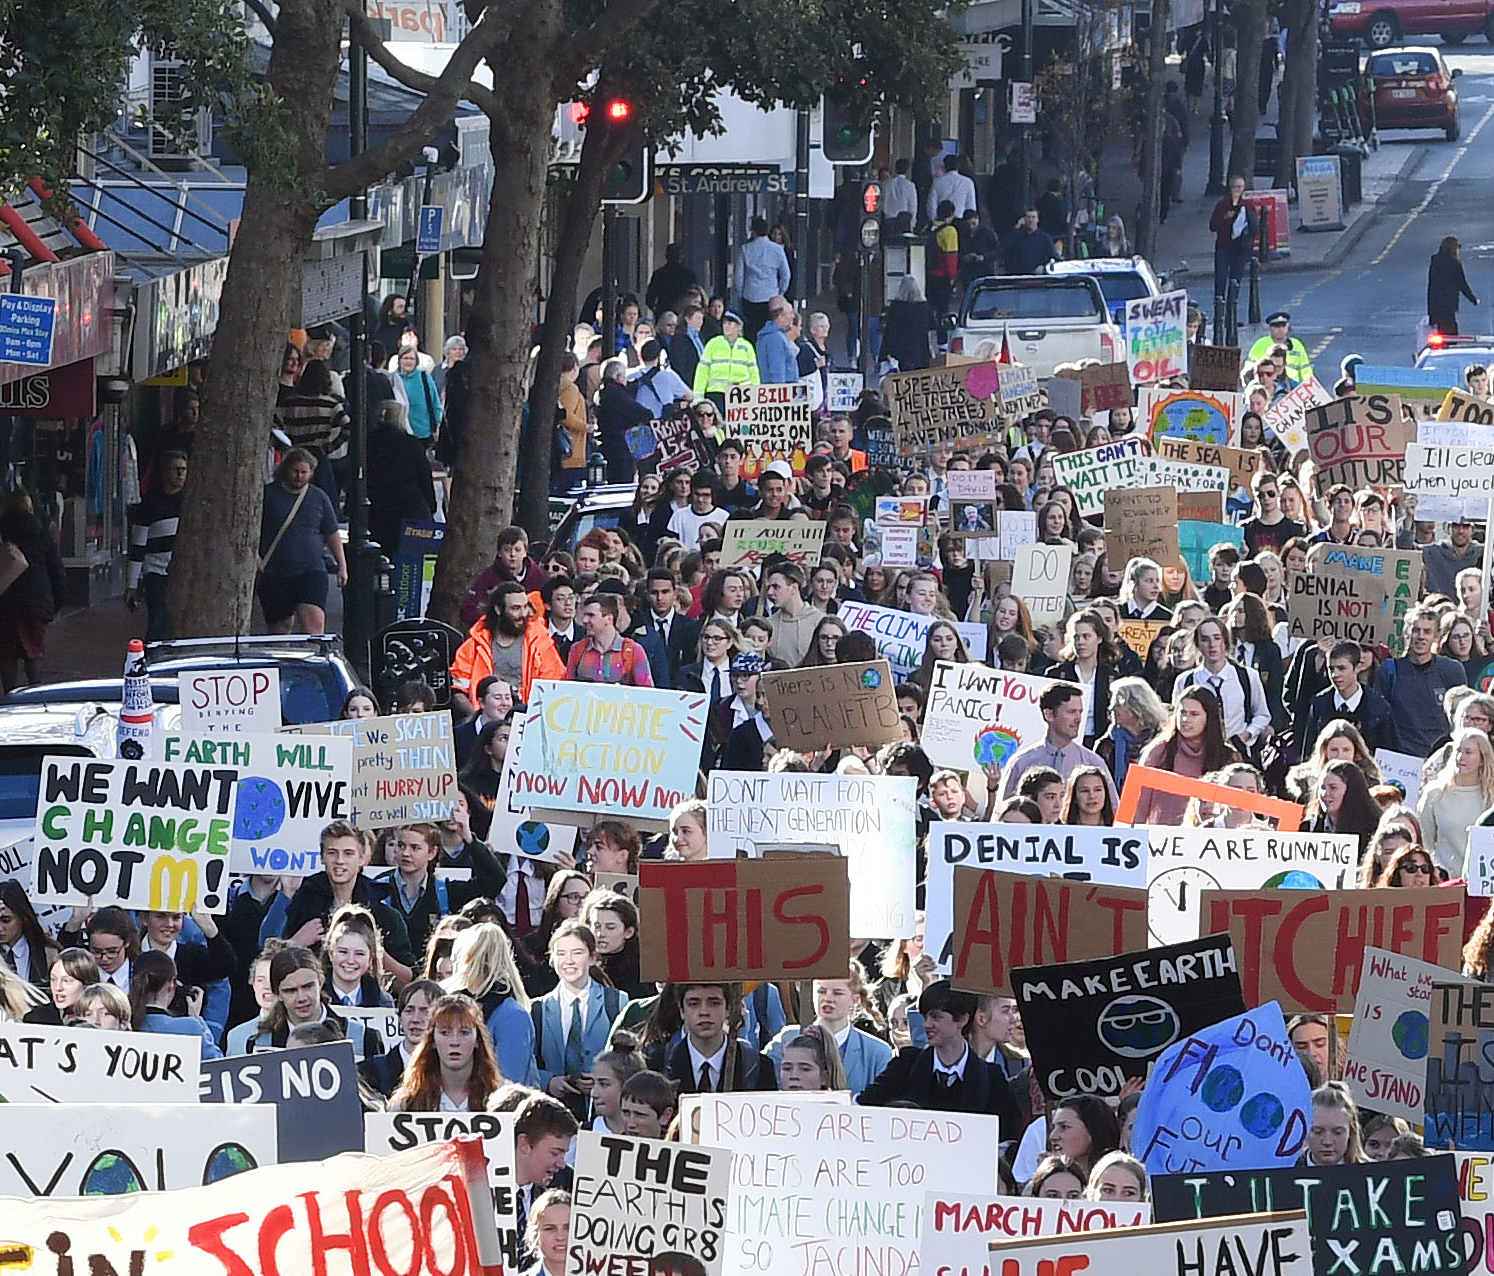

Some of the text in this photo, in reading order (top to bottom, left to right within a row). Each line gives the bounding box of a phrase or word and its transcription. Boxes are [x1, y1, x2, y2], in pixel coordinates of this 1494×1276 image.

[668, 175, 788, 192] St. Andrew St
[1128, 295, 1187, 321] SWEAT
[1132, 358, 1181, 381] OIL
[729, 386, 791, 404] AS BILL
[895, 388, 966, 413] THE TREES
[728, 404, 810, 422] NYE SAID THE
[1162, 442, 1256, 473] THE SEA IS
[1294, 575, 1359, 598] DENIAL
[843, 604, 875, 632] THE
[1318, 599, 1373, 618] IS NOT
[1291, 618, 1375, 644] A POLICY!
[191, 673, 270, 710] STOP
[366, 711, 452, 745] We SKATE
[164, 736, 334, 771] EARTH WILL
[357, 745, 451, 774] pretty THIN
[45, 762, 239, 815] WE WANT
[375, 773, 454, 799] HURRY UP
[516, 771, 651, 809] NOW NOW
[41, 805, 231, 856] CHANGE
[944, 833, 1142, 870] DENIAL IS
[1147, 836, 1352, 865] WE ARE RUNNING
[639, 863, 830, 982] THIS
[1364, 1002, 1383, 1021] IS
[105, 1043, 184, 1083] YOUR
[715, 1099, 964, 1144] ROSES ARE DEAD
[599, 1138, 712, 1194] THE
[574, 1176, 726, 1229] EARTH IS
